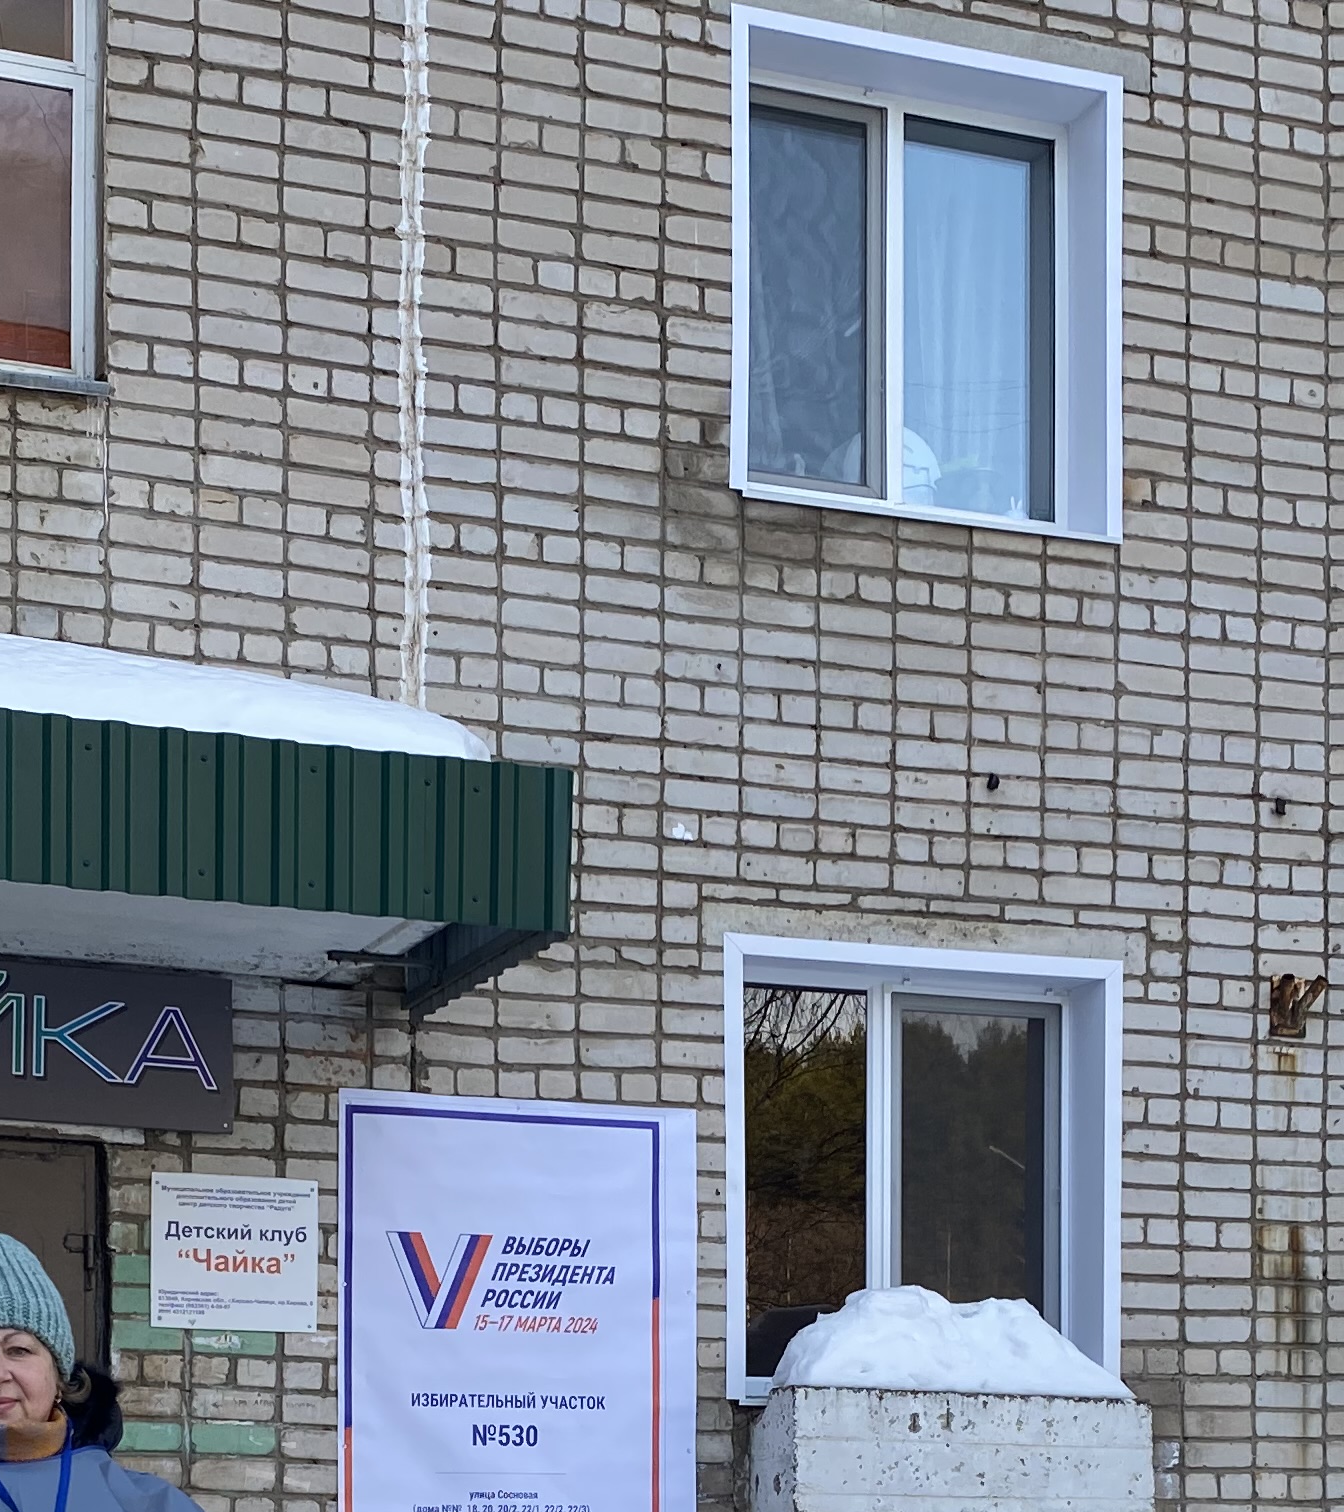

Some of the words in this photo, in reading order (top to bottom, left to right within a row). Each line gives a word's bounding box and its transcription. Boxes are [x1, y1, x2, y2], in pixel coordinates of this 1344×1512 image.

[165, 1221, 252, 1241] Детский
[259, 1226, 307, 1246] клуб
[501, 1236, 591, 1258] ВЫБОРЫ
[491, 1262, 616, 1287] ПРЕЗИДЕНТА
[480, 1288, 563, 1310] РОССИИ
[514, 1315, 562, 1333] МАРТА
[563, 1317, 599, 1334] 2024
[411, 1392, 536, 1409] ИЗБИРАТЕЛЬНЫЙ
[540, 1395, 606, 1410] УЧАСТОК
[472, 1424, 538, 1447] №530
[469, 1491, 496, 1501] улица
[497, 1490, 538, 1500] Сосновая
